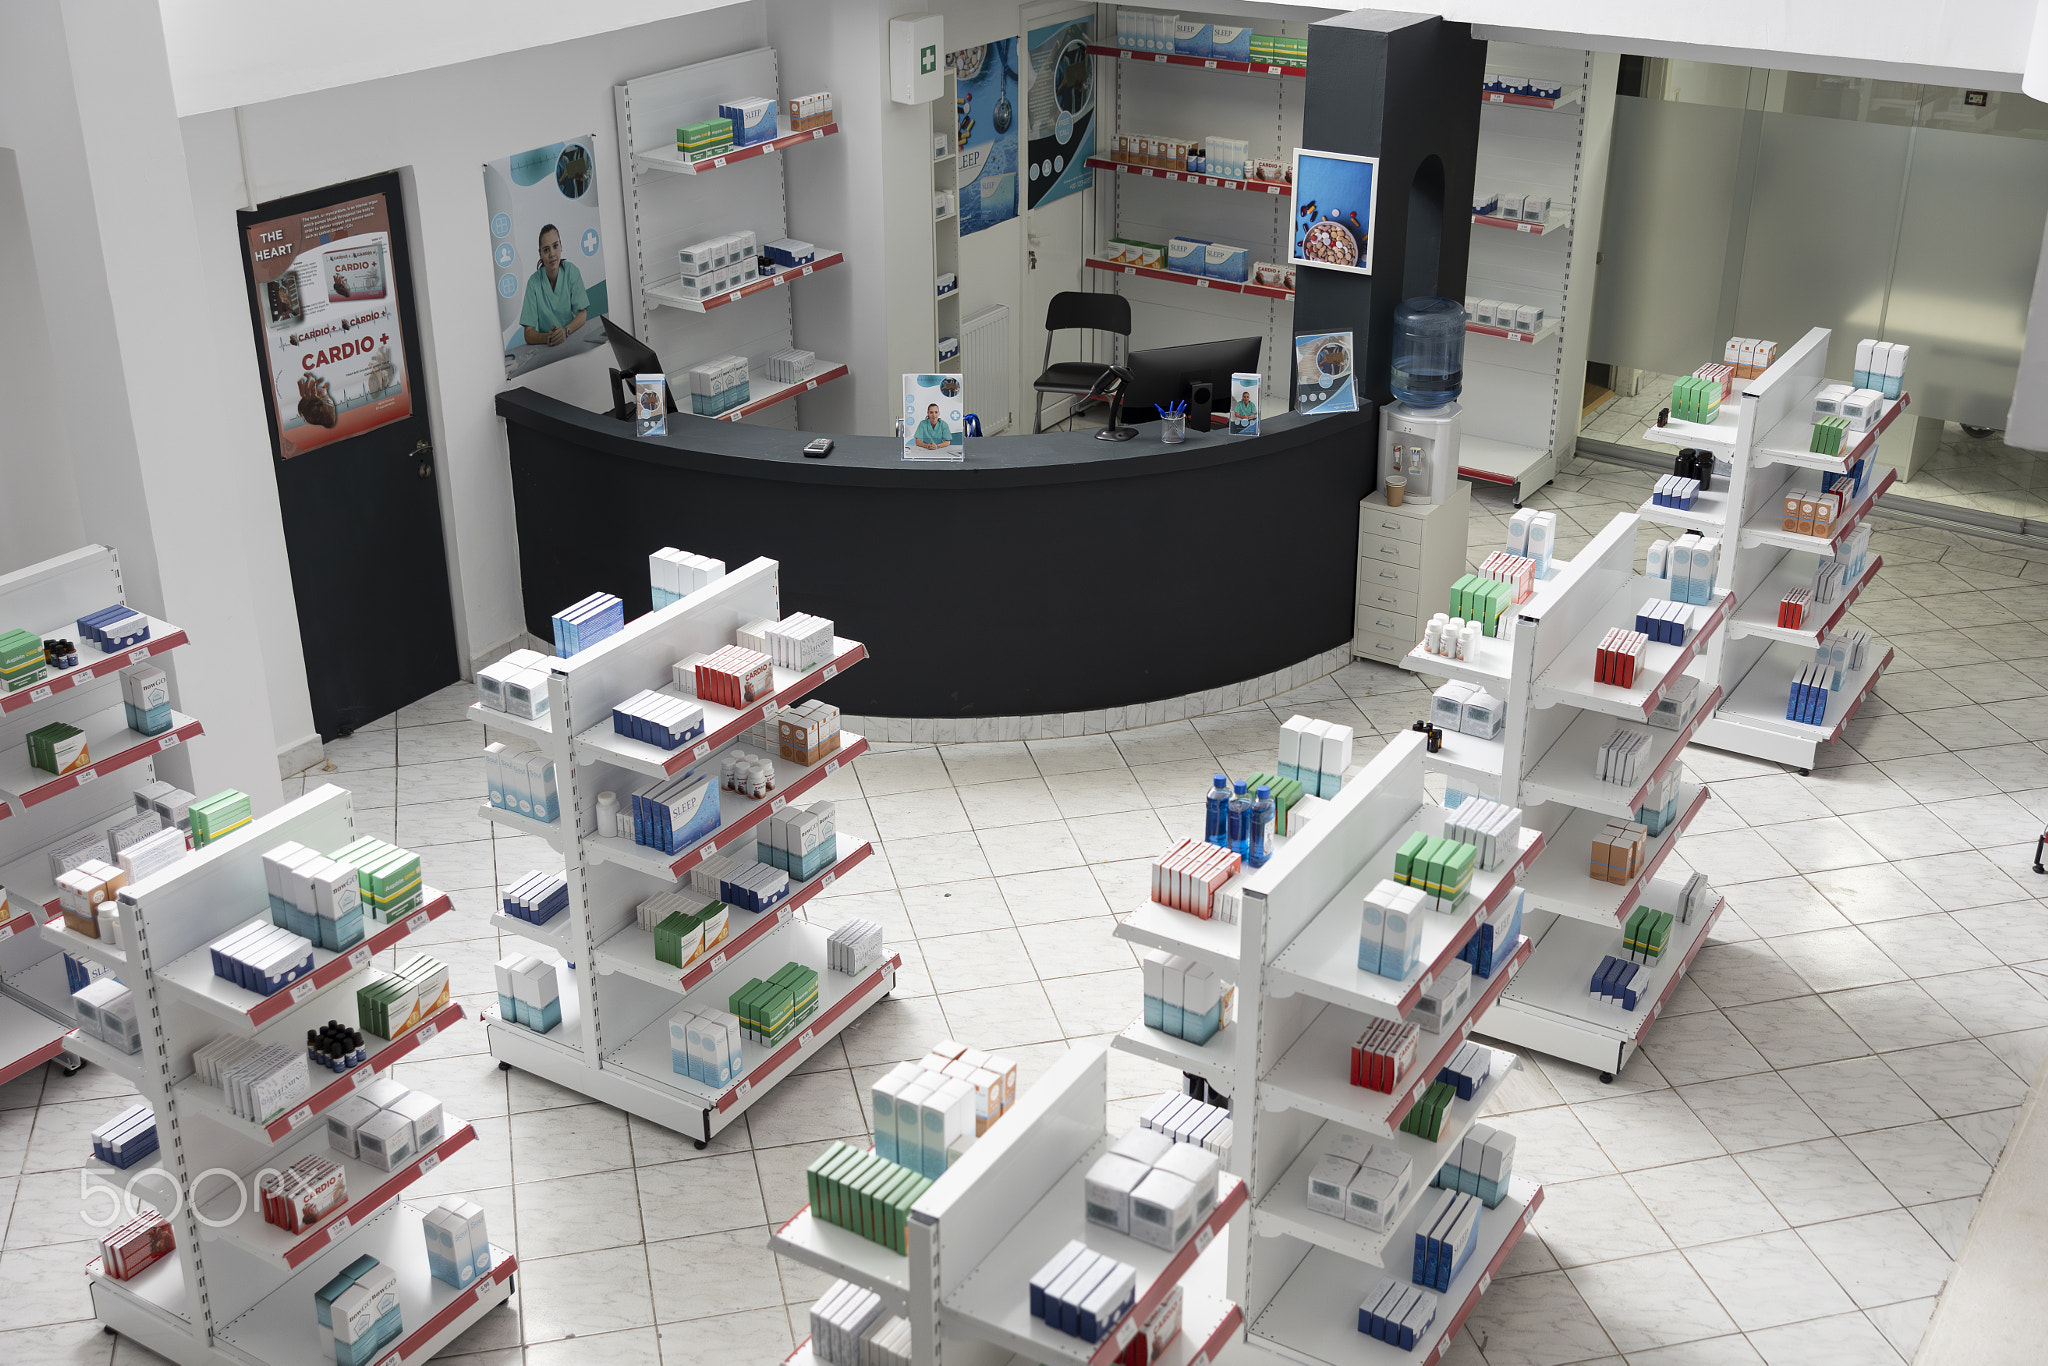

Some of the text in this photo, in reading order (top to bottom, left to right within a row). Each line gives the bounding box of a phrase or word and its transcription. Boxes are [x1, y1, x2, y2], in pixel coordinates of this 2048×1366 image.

[1176, 24, 1195, 33] SLEEP
[1214, 28, 1233, 37] SLEEP
[745, 109, 761, 120] SLEEP
[959, 151, 980, 170] EEP
[1258, 161, 1277, 169] CARDIO
[260, 229, 284, 243] THE
[254, 243, 293, 262] HEART
[1170, 244, 1188, 252] SLEEP
[1206, 250, 1225, 259] SLEEP
[335, 261, 369, 272] CARDIO
[1257, 266, 1277, 274] CARDIO
[350, 311, 380, 327] CARDIO
[298, 327, 330, 342] CARDIO
[302, 335, 375, 371] CARDIO
[6, 653, 26, 665] Aspirin
[38, 670, 47, 681] 30
[745, 664, 768, 682] CARDIO
[143, 677, 166, 691] nowGO
[672, 797, 697, 819] SLEEP
[333, 874, 358, 895] nowGO
[1495, 913, 1510, 936] SLEEP
[1399, 1036, 1416, 1061] CARDIO
[303, 1176, 336, 1203] CARDIO
[1454, 1228, 1470, 1252] SLEEP
[371, 1278, 397, 1300] nowGO
[349, 1298, 372, 1323] nowGO
[1153, 1300, 1178, 1336] CARDIO
